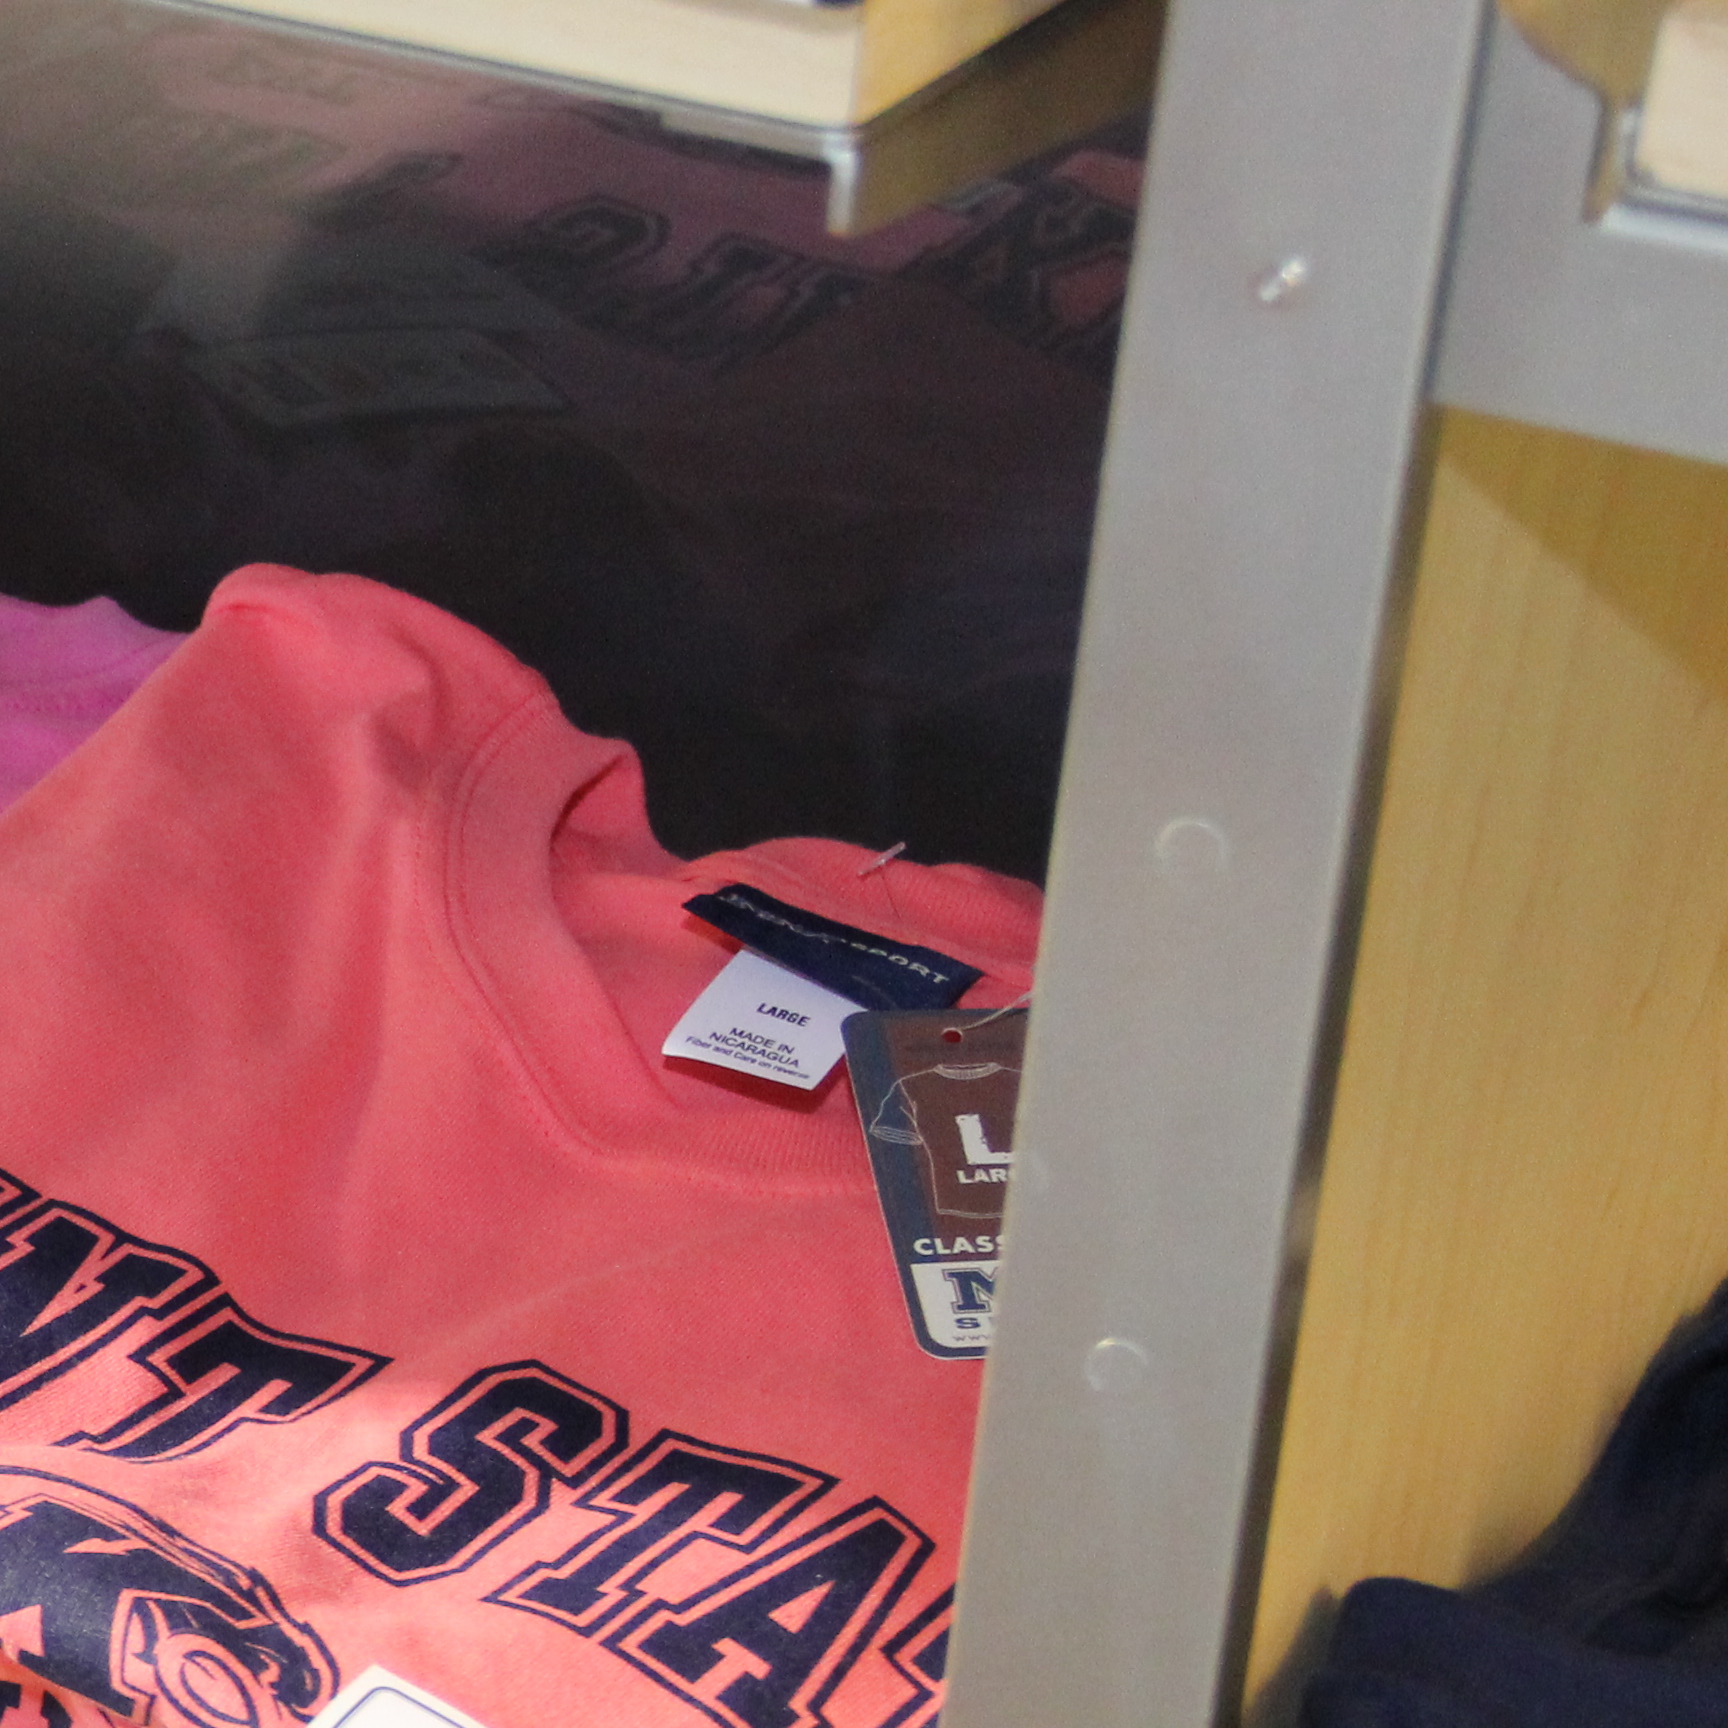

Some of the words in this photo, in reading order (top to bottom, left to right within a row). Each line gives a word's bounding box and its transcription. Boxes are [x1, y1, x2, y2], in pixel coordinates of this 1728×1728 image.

[756, 1002, 811, 1028] LARGE
[709, 1031, 801, 1069] NICARAGUA
[728, 1026, 776, 1049] MADE
[779, 1042, 796, 1055] IN
